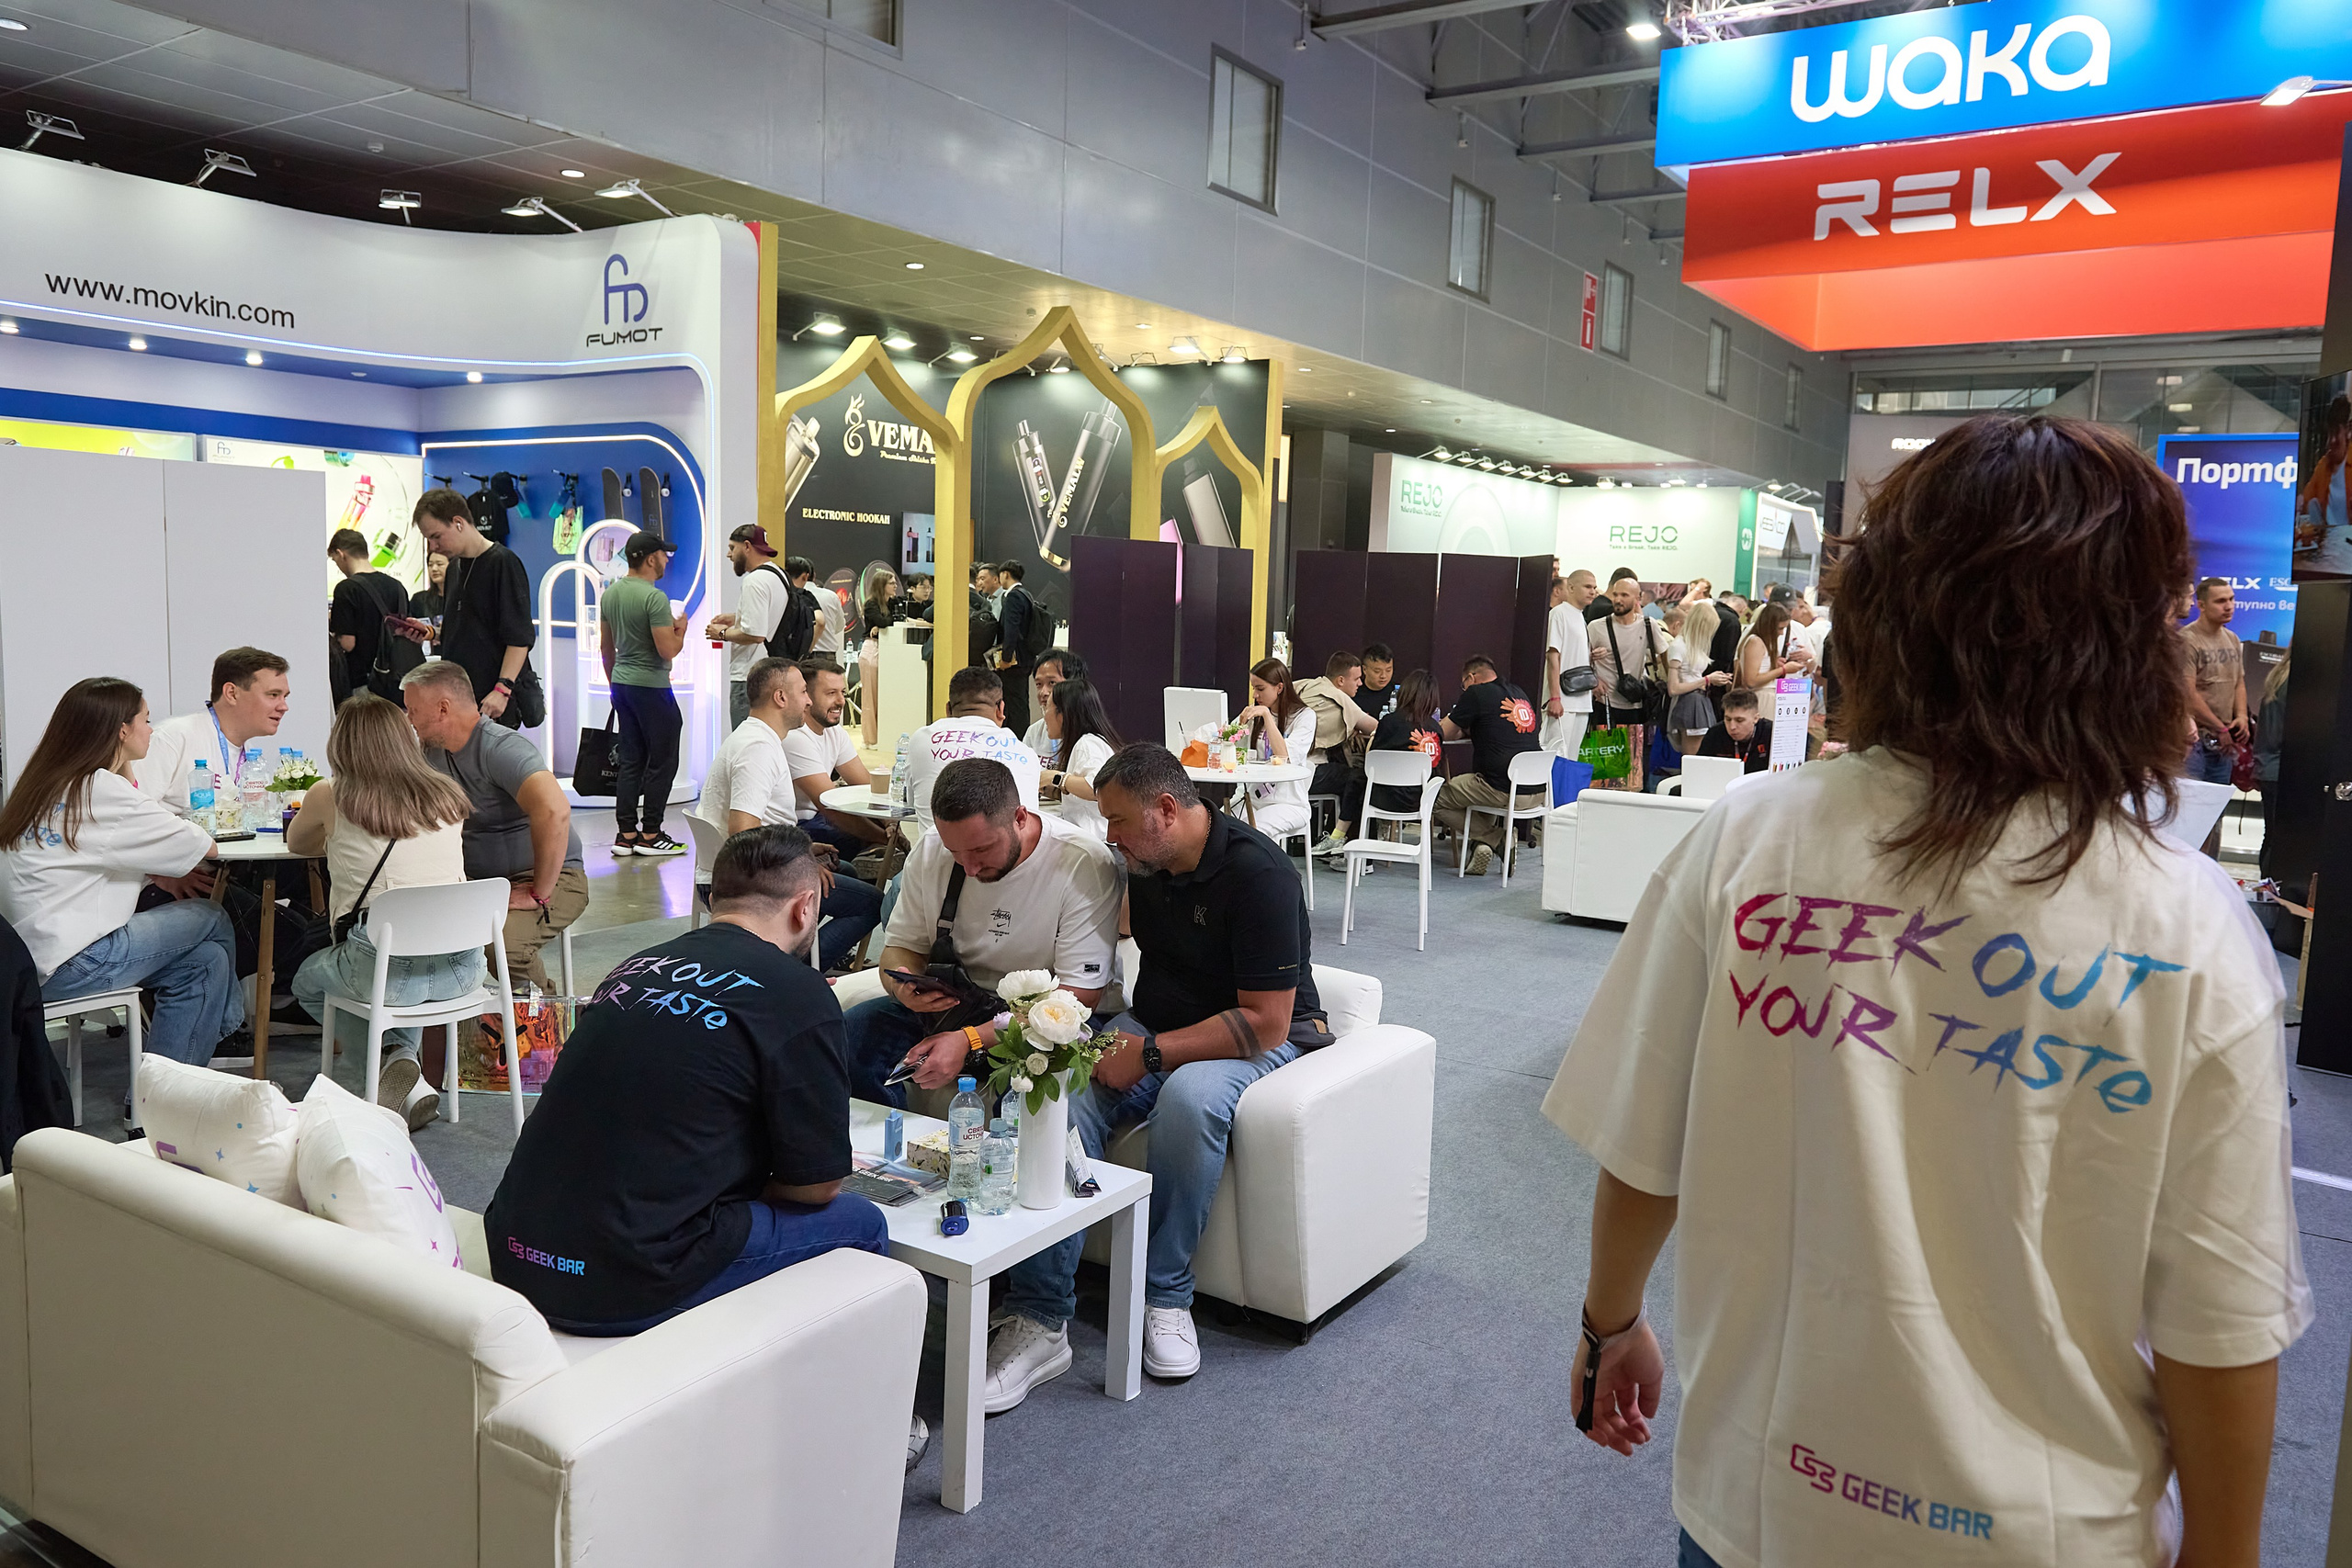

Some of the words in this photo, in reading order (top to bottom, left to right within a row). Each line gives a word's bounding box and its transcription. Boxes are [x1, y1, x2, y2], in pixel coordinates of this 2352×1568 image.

[1814, 152, 2123, 241] RELX
[45, 274, 295, 329] www.movkin.com
[586, 327, 663, 347] FUMOT
[2177, 456, 2299, 490] Портф
[1400, 479, 1442, 508] REJO
[802, 508, 855, 522] ELECTRONIC
[856, 513, 891, 525] HOOKAH
[1610, 525, 1679, 543] REJO
[931, 731, 985, 745] GEEK
[986, 735, 1017, 748] OUT
[931, 747, 975, 761] YOUR
[1734, 892, 1973, 978] GEEK
[1972, 932, 2190, 1010] OUT
[602, 955, 686, 982] EEK
[672, 963, 765, 996] OUT
[1728, 970, 1918, 1075] YOUR
[526, 1247, 556, 1269] GEEK
[557, 1257, 585, 1276] BAR
[1841, 1472, 1922, 1526] GEEK
[1928, 1502, 1994, 1540] BAR
